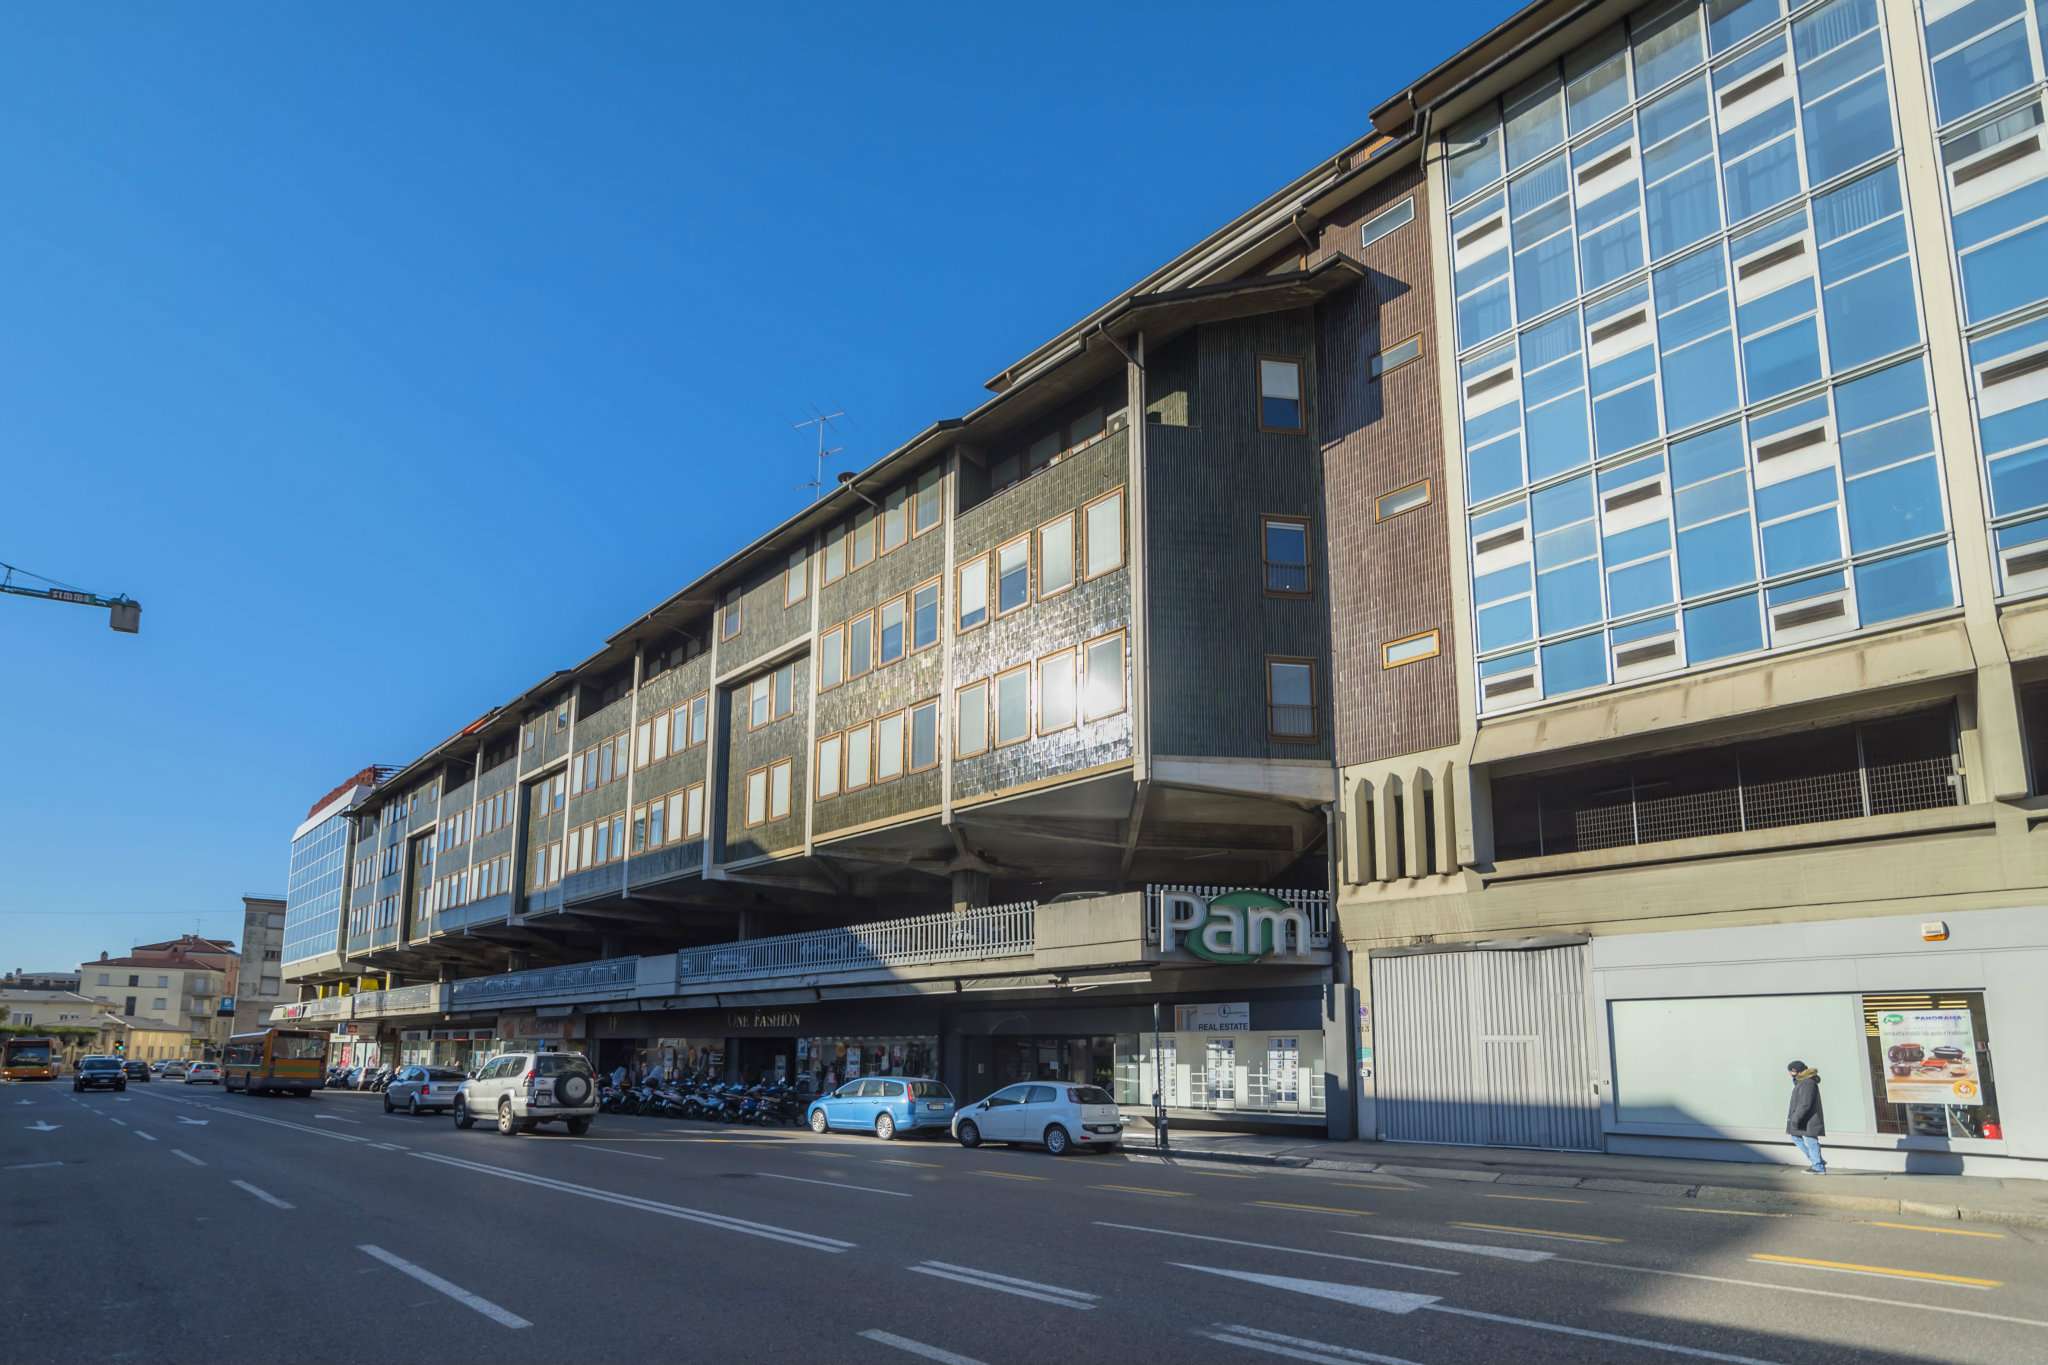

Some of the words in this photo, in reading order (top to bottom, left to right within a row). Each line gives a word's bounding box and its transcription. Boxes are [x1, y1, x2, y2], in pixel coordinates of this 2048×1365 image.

[1161, 889, 1311, 957] Pam
[1199, 1023, 1217, 1031] REAL
[1219, 1023, 1248, 1031] ESTATE
